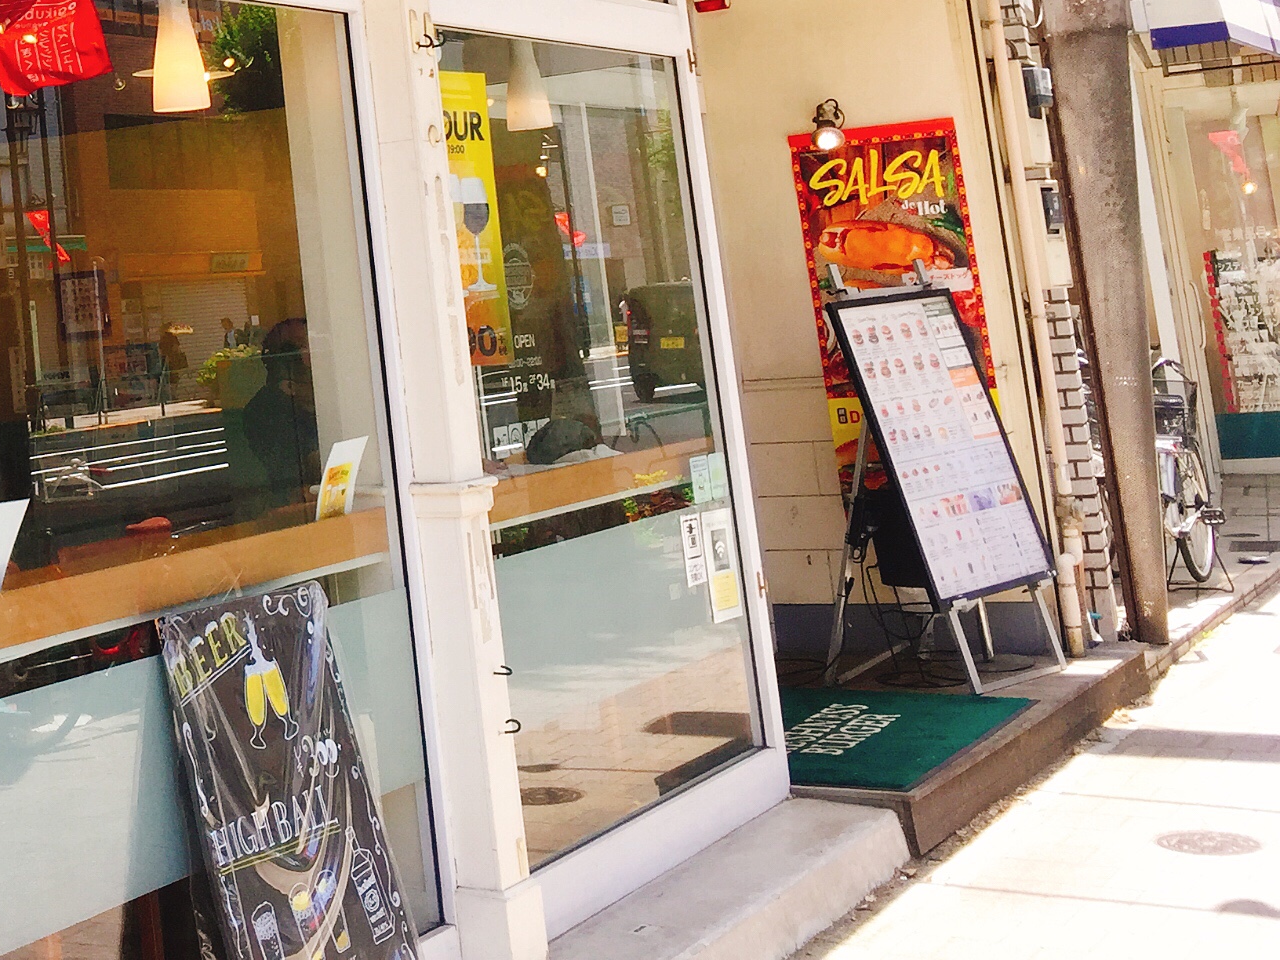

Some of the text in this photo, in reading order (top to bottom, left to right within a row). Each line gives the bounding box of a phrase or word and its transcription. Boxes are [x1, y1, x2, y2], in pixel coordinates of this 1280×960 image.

[809, 149, 946, 207] SALSA
[916, 199, 949, 217] Hot
[514, 334, 536, 349] OPEN
[170, 611, 248, 699] BEER
[800, 713, 901, 756] BURGER
